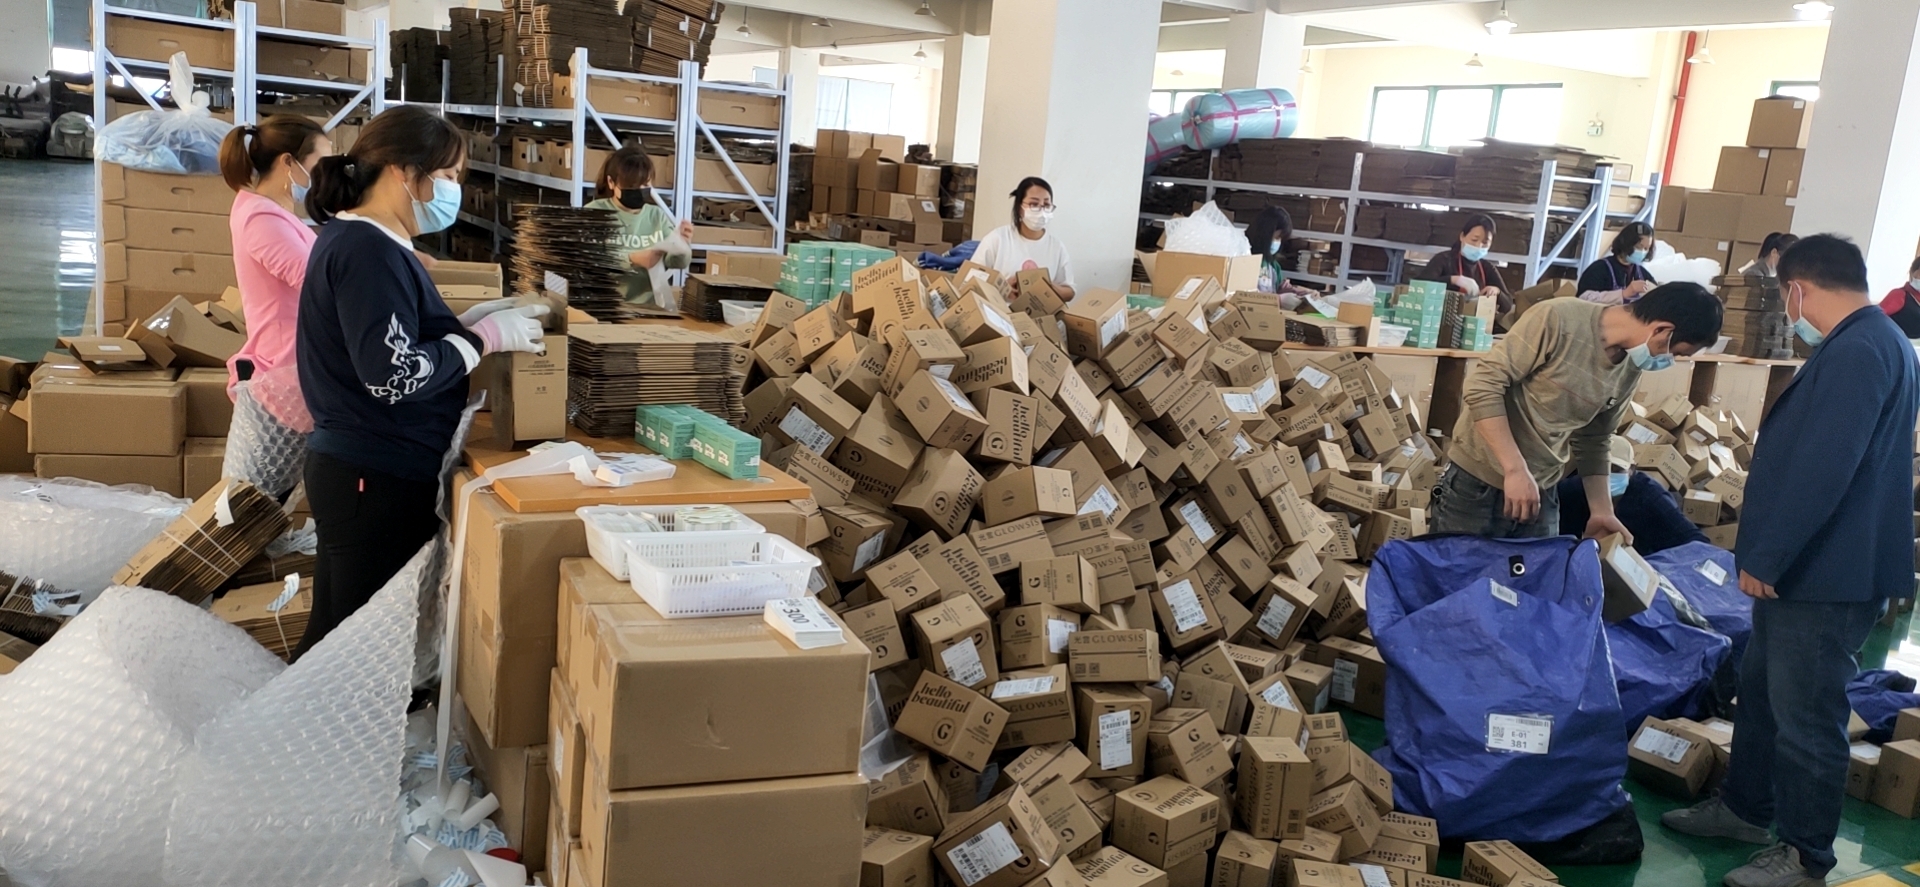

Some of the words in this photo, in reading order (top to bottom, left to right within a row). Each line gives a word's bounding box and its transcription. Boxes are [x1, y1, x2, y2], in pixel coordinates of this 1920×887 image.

[854, 262, 898, 292] beautiful
[858, 268, 881, 284] hello
[901, 288, 916, 314] hello
[975, 366, 1003, 382] hello
[1123, 357, 1152, 382] GLOWSIS
[1156, 387, 1182, 413] GLOWSIS
[1020, 405, 1030, 438] hello
[1012, 398, 1024, 462] beautiful
[991, 437, 1004, 450] G
[811, 457, 850, 487] GLOWSIS
[948, 468, 976, 530] beautiful
[964, 478, 978, 510] hello
[934, 496, 946, 512] G
[834, 526, 845, 538] G
[994, 518, 1040, 538] GLOWSIS
[952, 547, 981, 579] hello
[940, 548, 995, 602] beautiful
[1028, 576, 1041, 588] G
[905, 585, 918, 597] G
[1208, 576, 1228, 598] hello
[783, 608, 810, 624] 300
[927, 616, 941, 626] G
[1015, 614, 1026, 628] G
[1092, 634, 1144, 644] GLOWSIS
[876, 644, 888, 658] G
[920, 682, 952, 698] hello
[911, 690, 972, 714] beautiful
[1010, 699, 1064, 713] GLOWSIS
[984, 711, 995, 725] G
[937, 723, 952, 740] G
[1188, 728, 1201, 742] G
[1511, 731, 1527, 739] E-01
[1510, 740, 1527, 749] 381
[950, 766, 960, 779] G
[1262, 764, 1276, 814] GLOWSIS
[1154, 785, 1198, 814] beautiful
[1177, 790, 1204, 806] hello
[1311, 811, 1346, 829] OWSIS
[1060, 828, 1076, 843] G
[1080, 856, 1104, 876] hello
[1081, 850, 1128, 882] beautiful
[1469, 858, 1494, 880] hello
